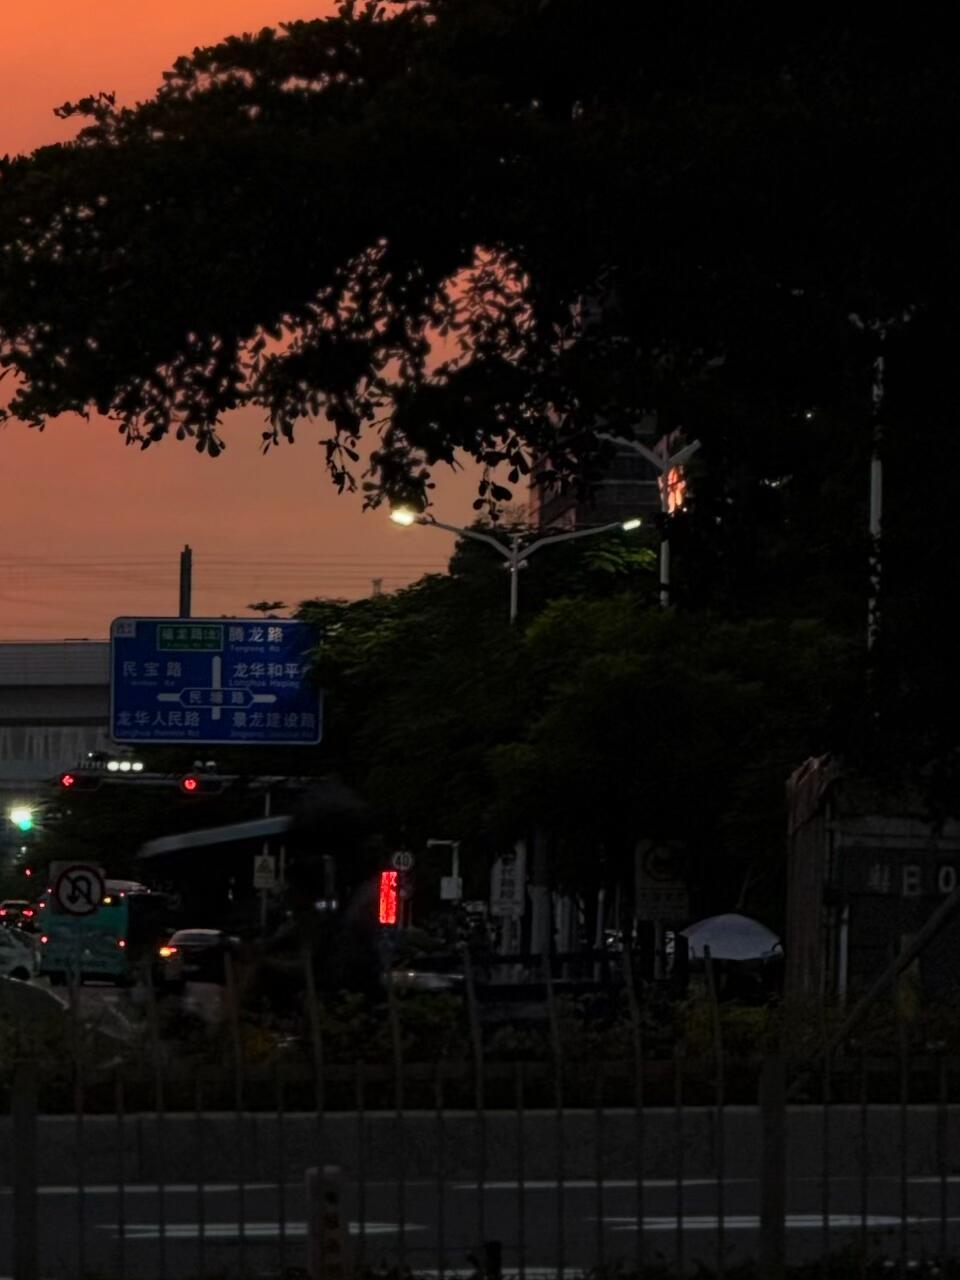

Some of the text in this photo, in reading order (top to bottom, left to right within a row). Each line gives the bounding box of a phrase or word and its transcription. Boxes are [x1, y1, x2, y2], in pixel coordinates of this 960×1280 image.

[123, 661, 182, 677] 民宝路
[232, 662, 312, 679] 龙华和平
[116, 710, 201, 727] 龙华人民路
